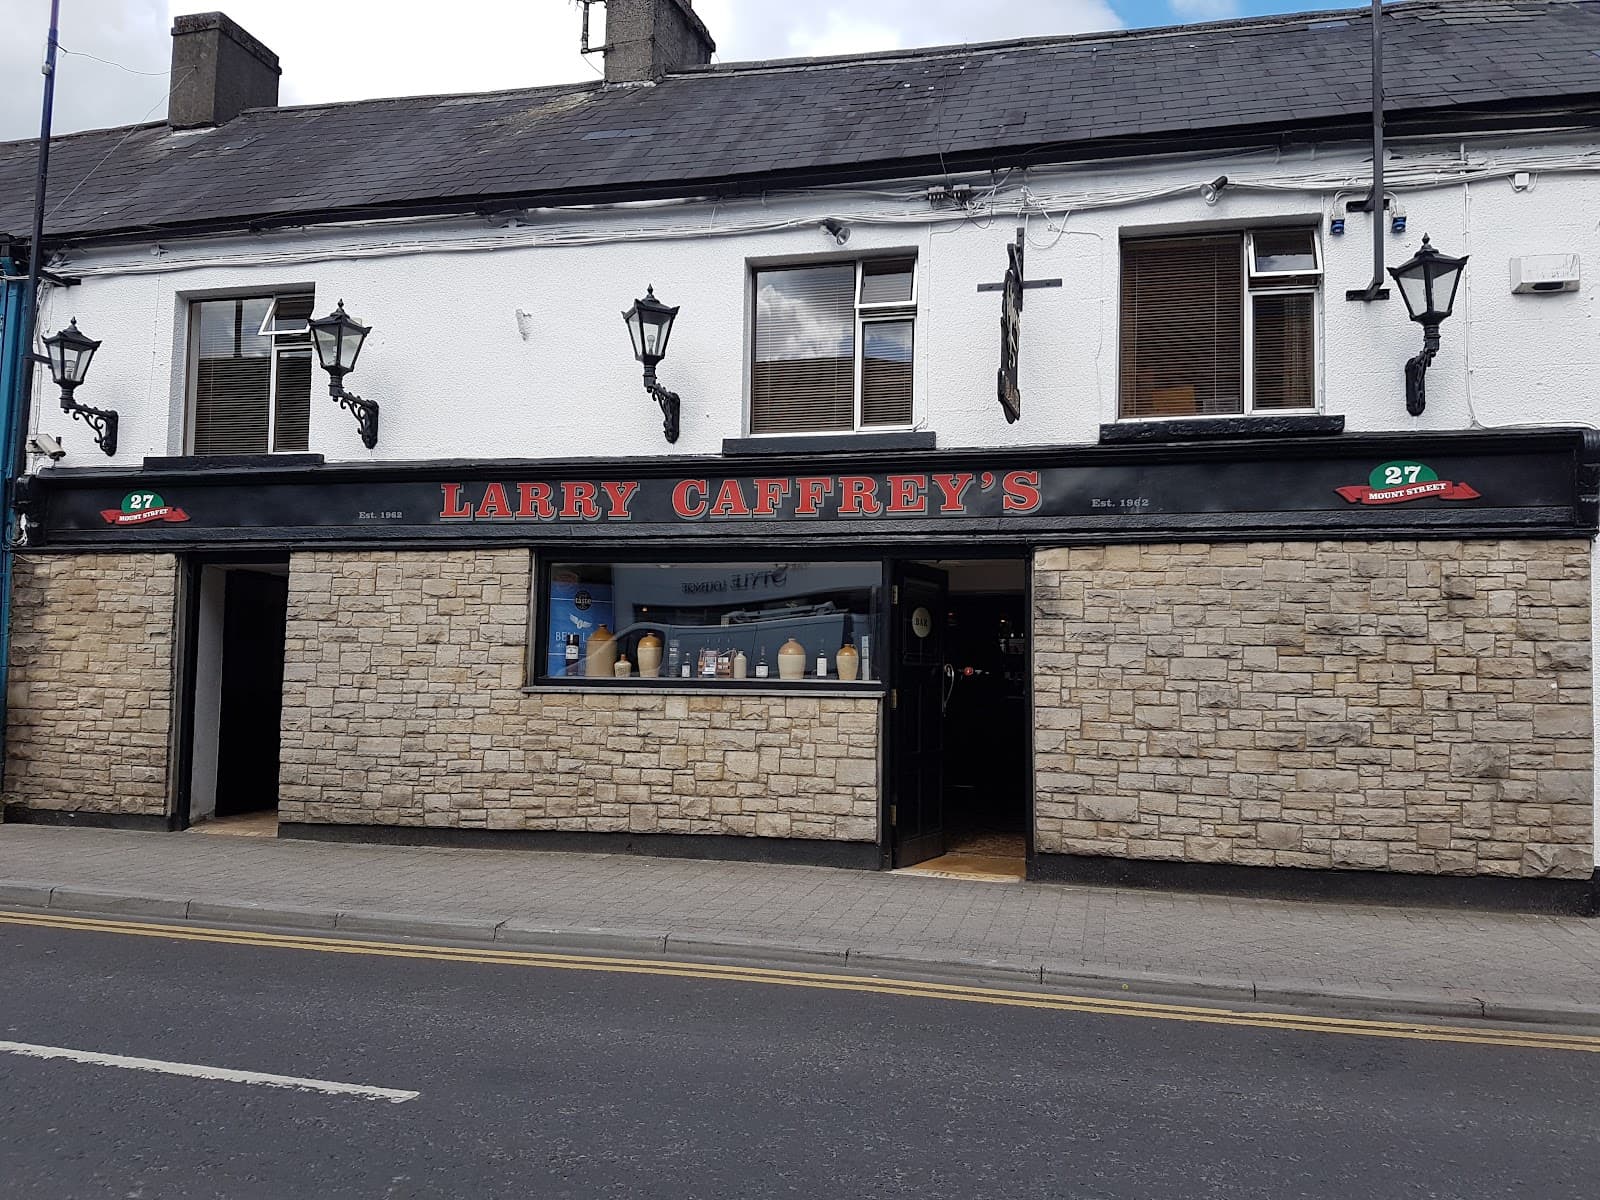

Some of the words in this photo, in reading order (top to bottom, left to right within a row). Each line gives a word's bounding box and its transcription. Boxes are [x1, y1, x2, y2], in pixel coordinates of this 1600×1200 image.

[1384, 465, 1421, 485] 27
[439, 481, 641, 522] LARRY
[671, 470, 1043, 520] CAFFREY'S
[1368, 490, 1405, 500] MOUNT
[1406, 483, 1447, 496] STREET
[130, 494, 154, 509] 27
[1091, 498, 1116, 508] Est.
[1119, 497, 1149, 507] 1962
[118, 512, 142, 522] MOUNT
[142, 508, 169, 519] STREET
[358, 511, 377, 519] Est.
[380, 511, 403, 519] 1962
